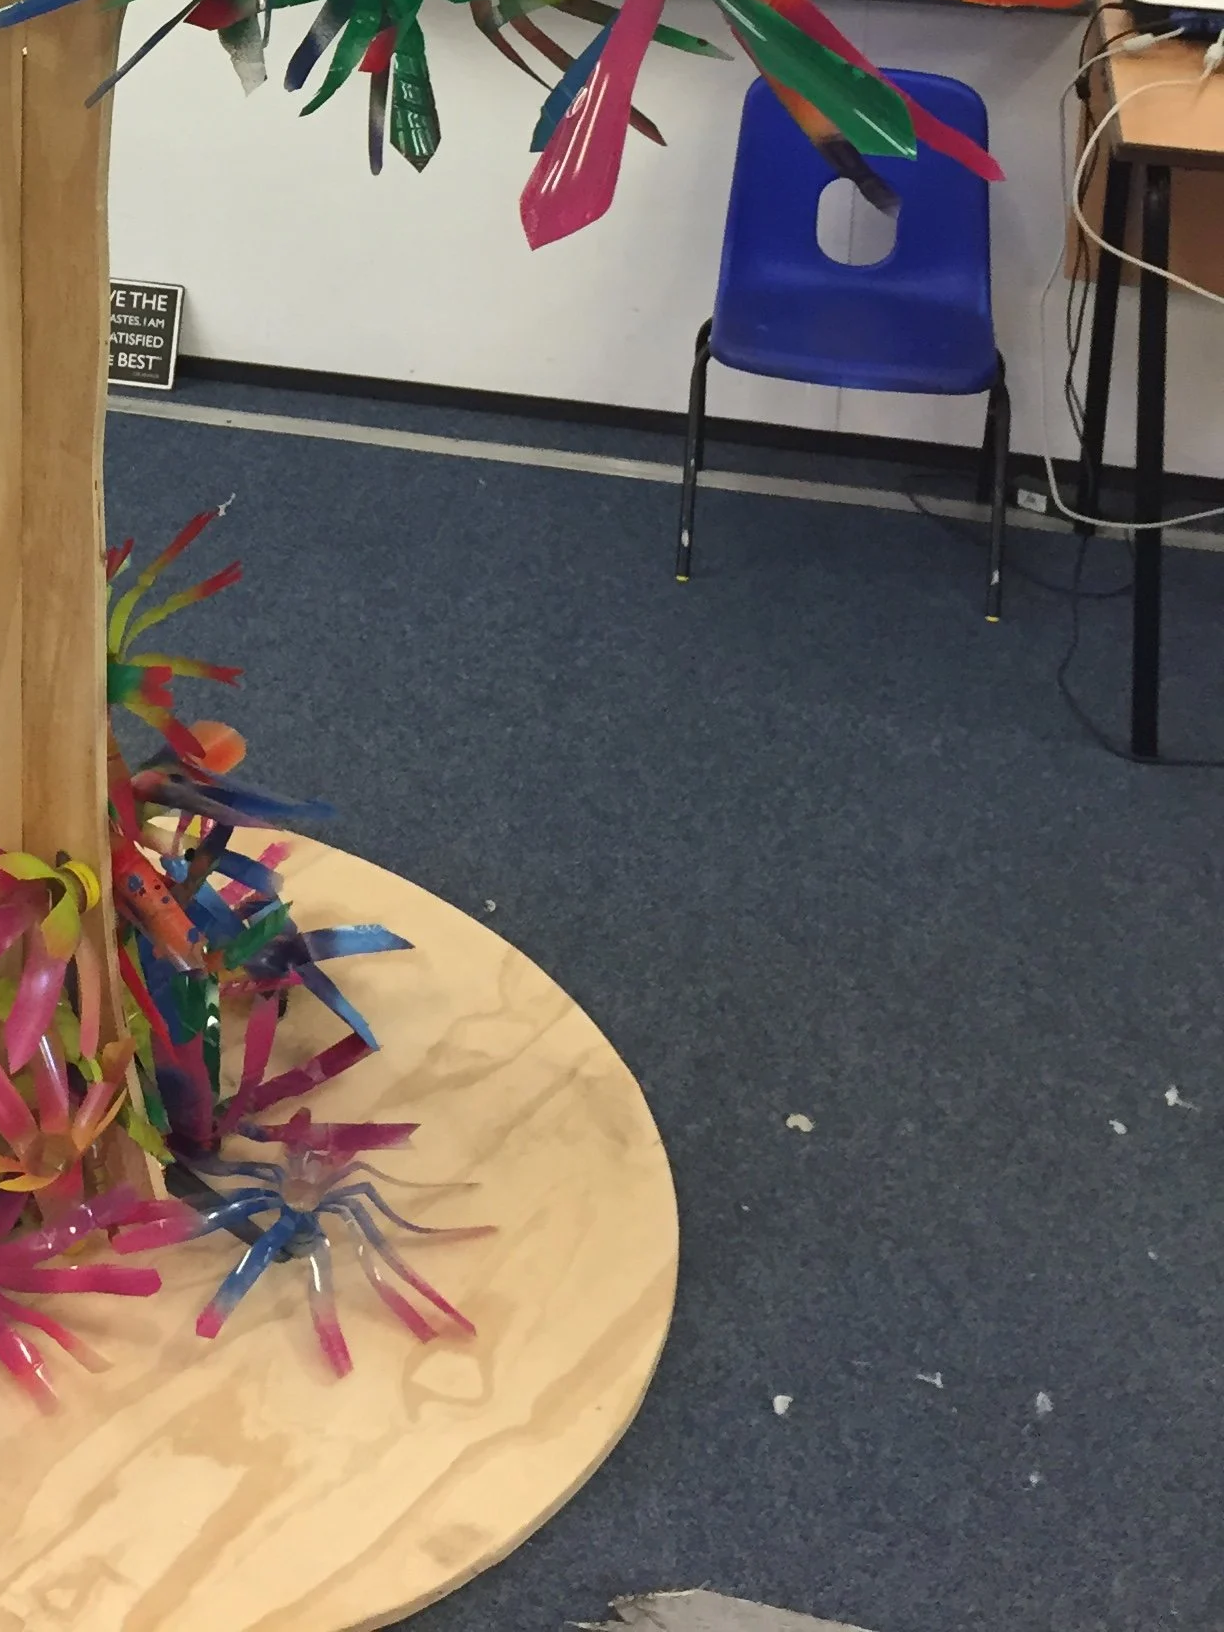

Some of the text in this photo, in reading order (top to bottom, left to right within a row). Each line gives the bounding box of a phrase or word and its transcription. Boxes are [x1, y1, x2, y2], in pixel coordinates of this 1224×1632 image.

[129, 291, 169, 312] THE
[147, 318, 166, 329] AM
[110, 331, 164, 348] ATISFIED
